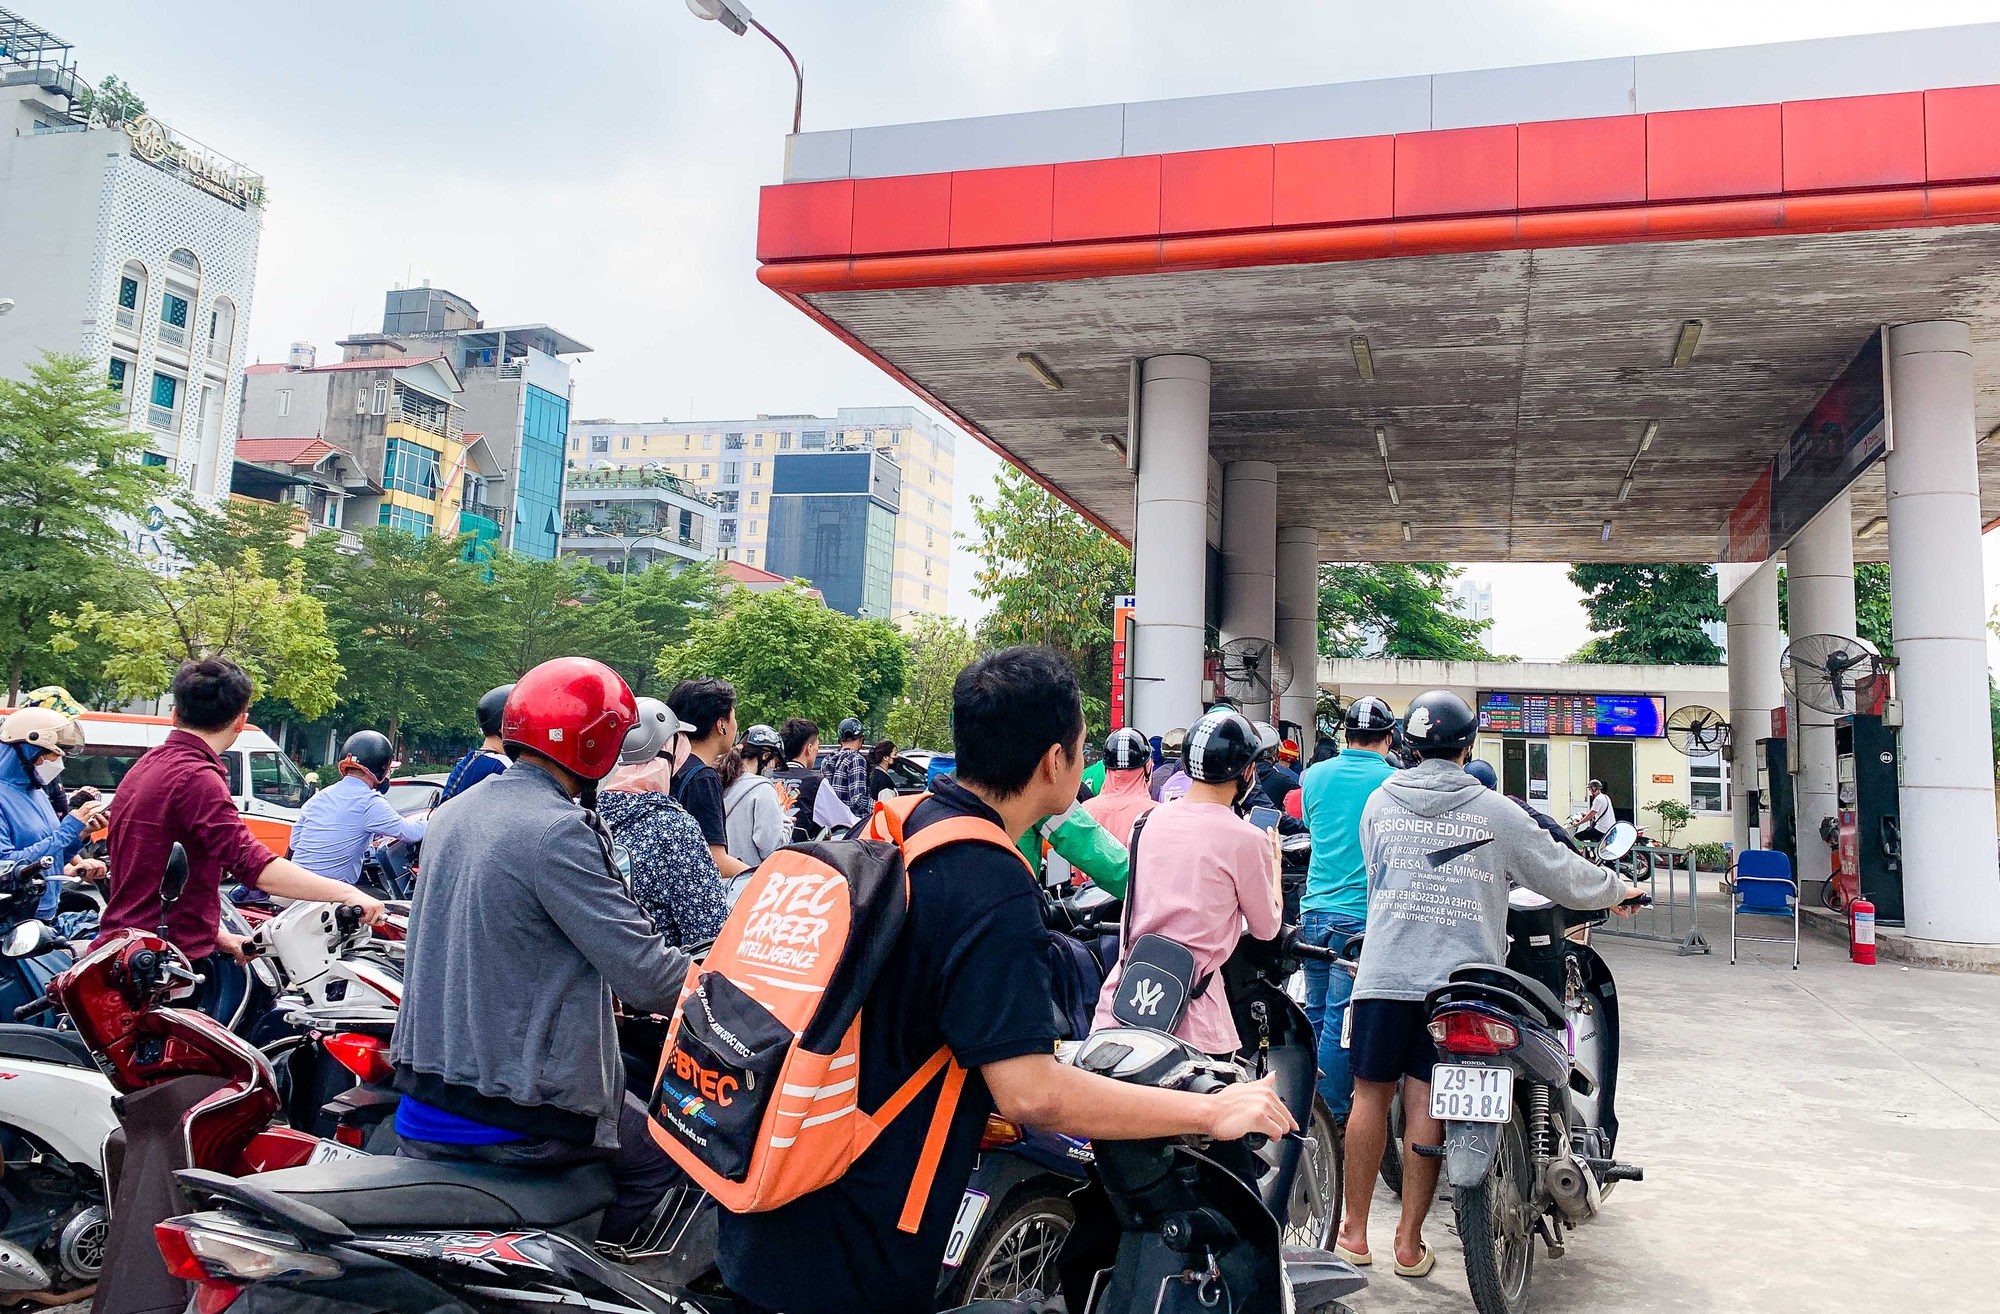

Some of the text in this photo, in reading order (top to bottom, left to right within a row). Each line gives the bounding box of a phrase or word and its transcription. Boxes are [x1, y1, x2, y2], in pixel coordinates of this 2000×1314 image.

[193, 175, 241, 204] COSMETICS
[1374, 819, 1494, 841] DESIGNER EDUTION
[1420, 836, 1446, 847] RUSH
[1397, 846, 1420, 856] RUSH
[1445, 876, 1464, 885] AWAY
[1454, 865, 1495, 884] MINGNER
[748, 871, 848, 916] BTEC
[743, 911, 829, 952] CAREER
[1435, 916, 1446, 925] TO
[1446, 918, 1458, 927] DE
[736, 940, 820, 969] INTELLIGENCE
[1129, 978, 1165, 1015] NY
[675, 1048, 739, 1107] BTEC
[1443, 1068, 1500, 1093] 29-Y1
[1436, 1093, 1505, 1119] 503.84
